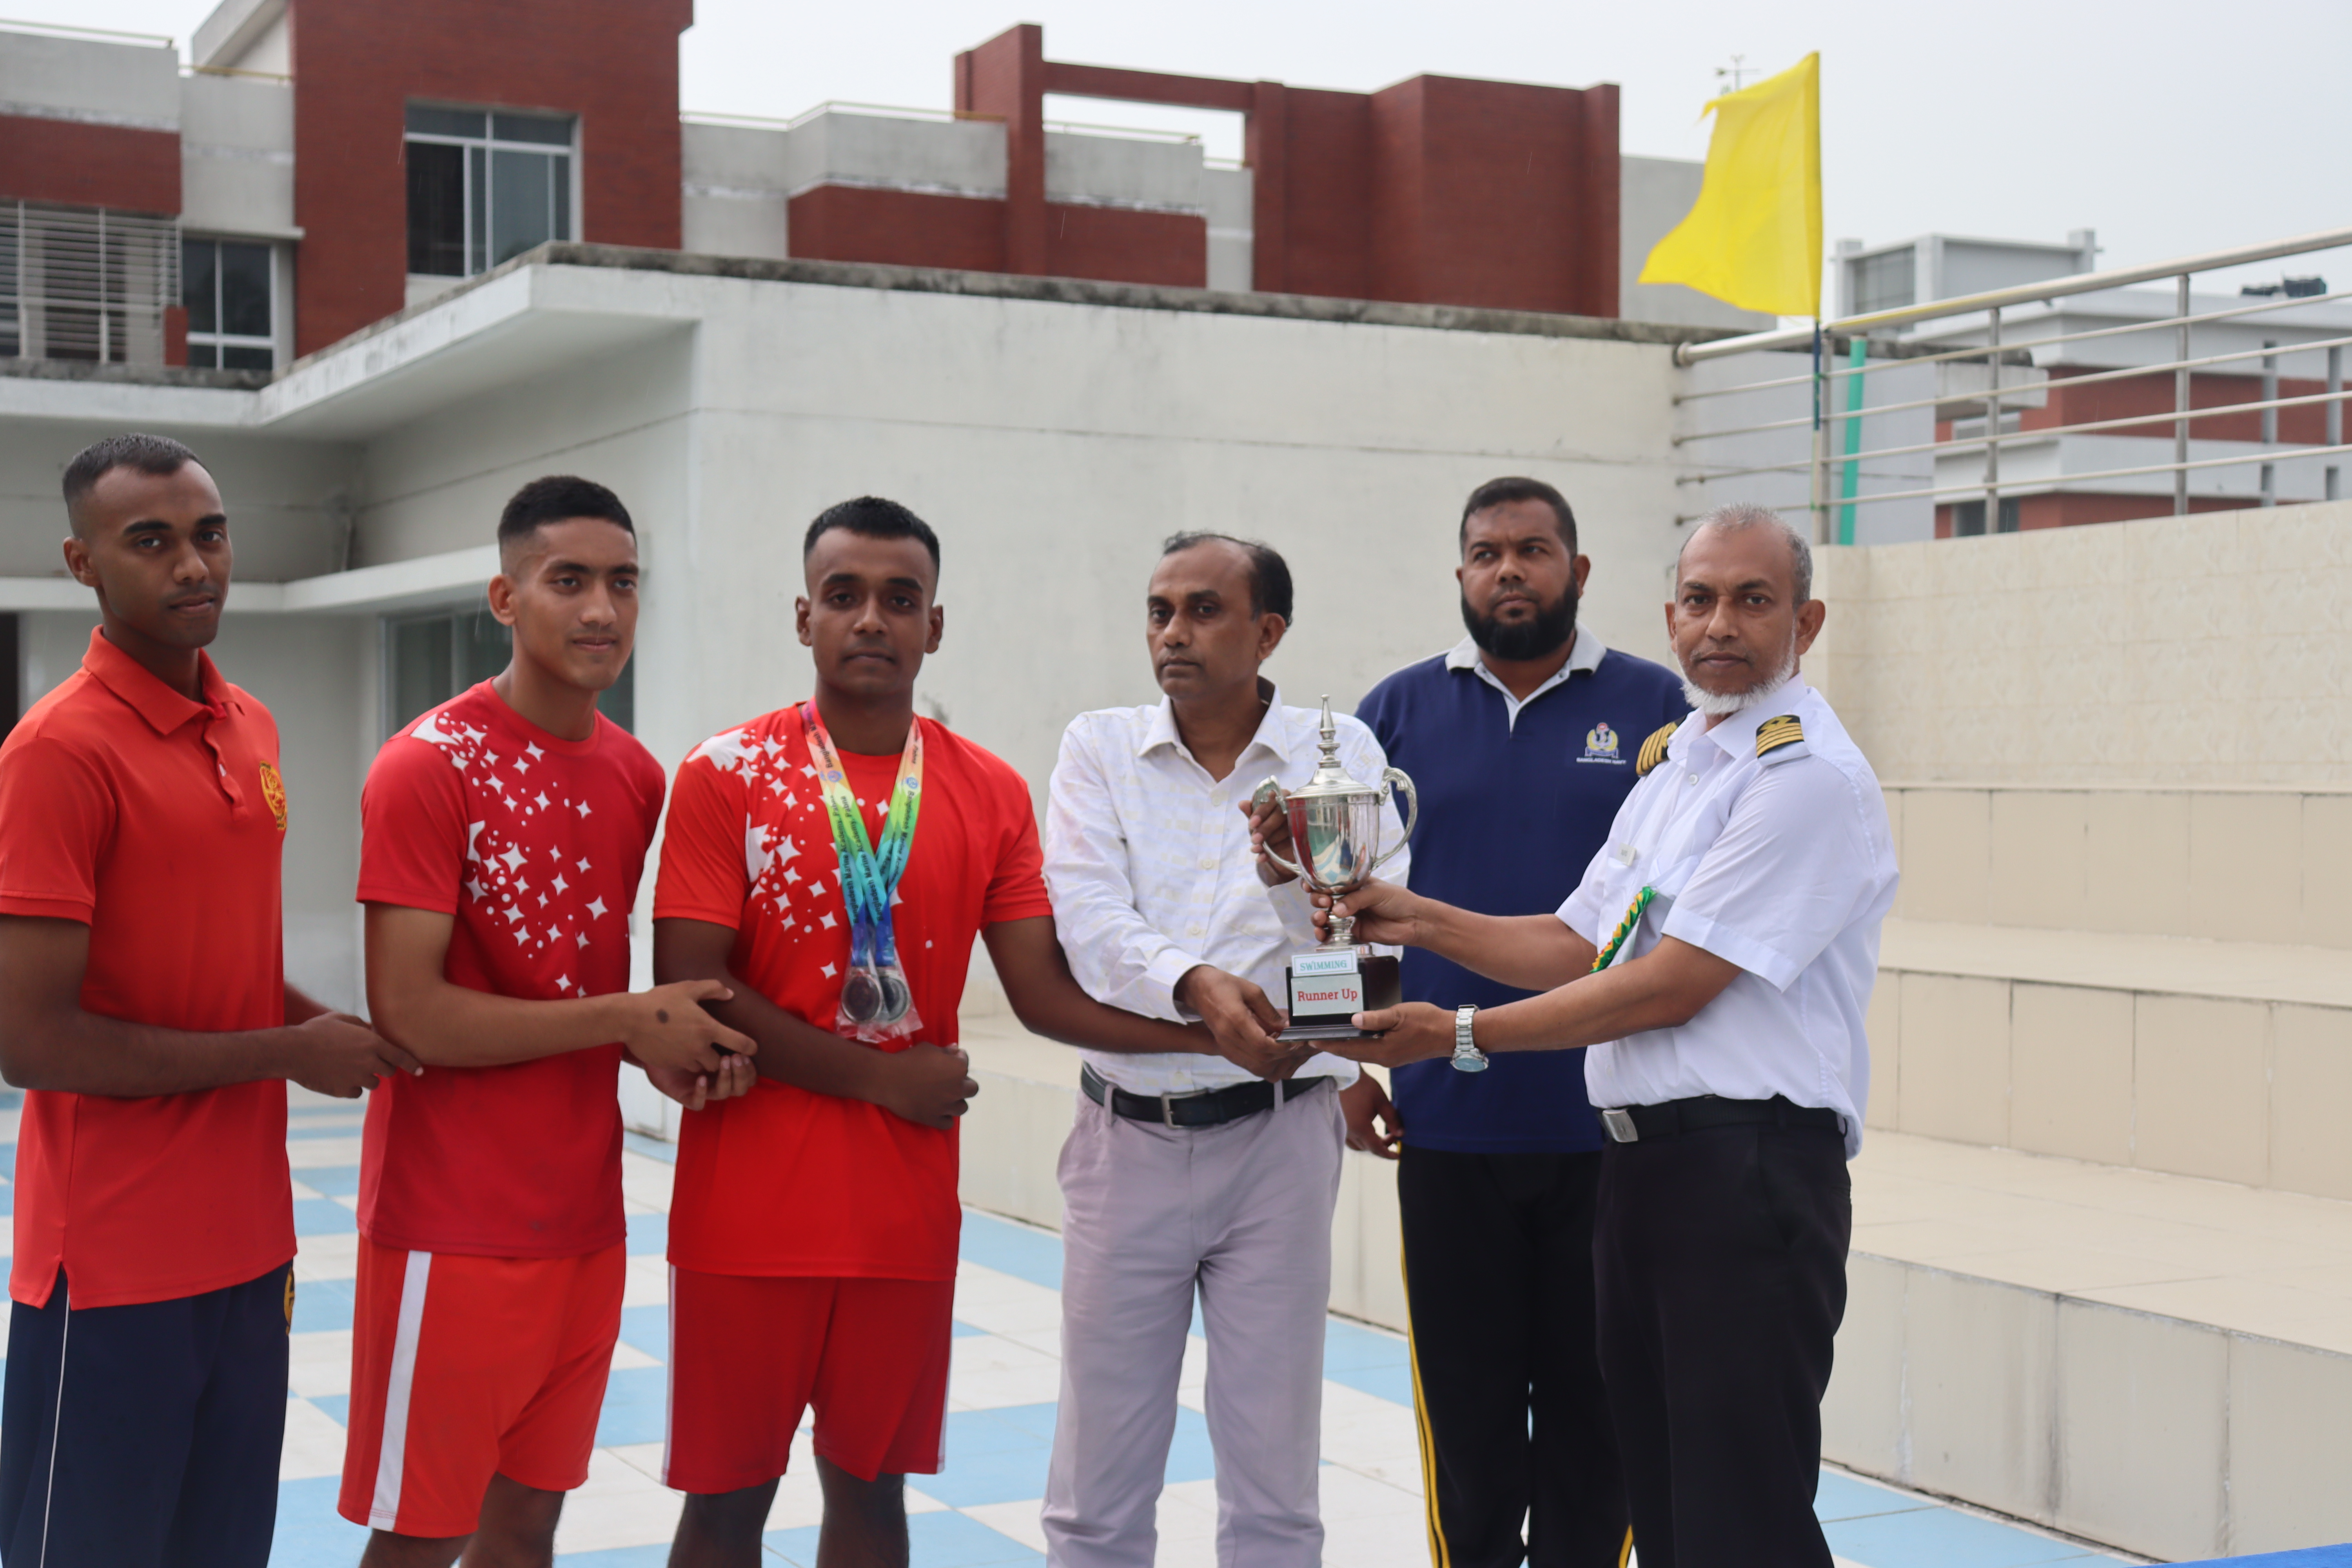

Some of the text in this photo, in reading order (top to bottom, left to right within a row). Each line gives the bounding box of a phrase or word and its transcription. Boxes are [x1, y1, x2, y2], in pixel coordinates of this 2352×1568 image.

[841, 796, 852, 817] Pabna
[843, 854, 852, 878] Marine
[861, 854, 872, 878] Marine
[847, 880, 859, 923] Bangladesh
[868, 879, 883, 921] Bangladesh
[1300, 960, 1347, 971] SWIMMING
[1298, 988, 1358, 1002] Runner Up
